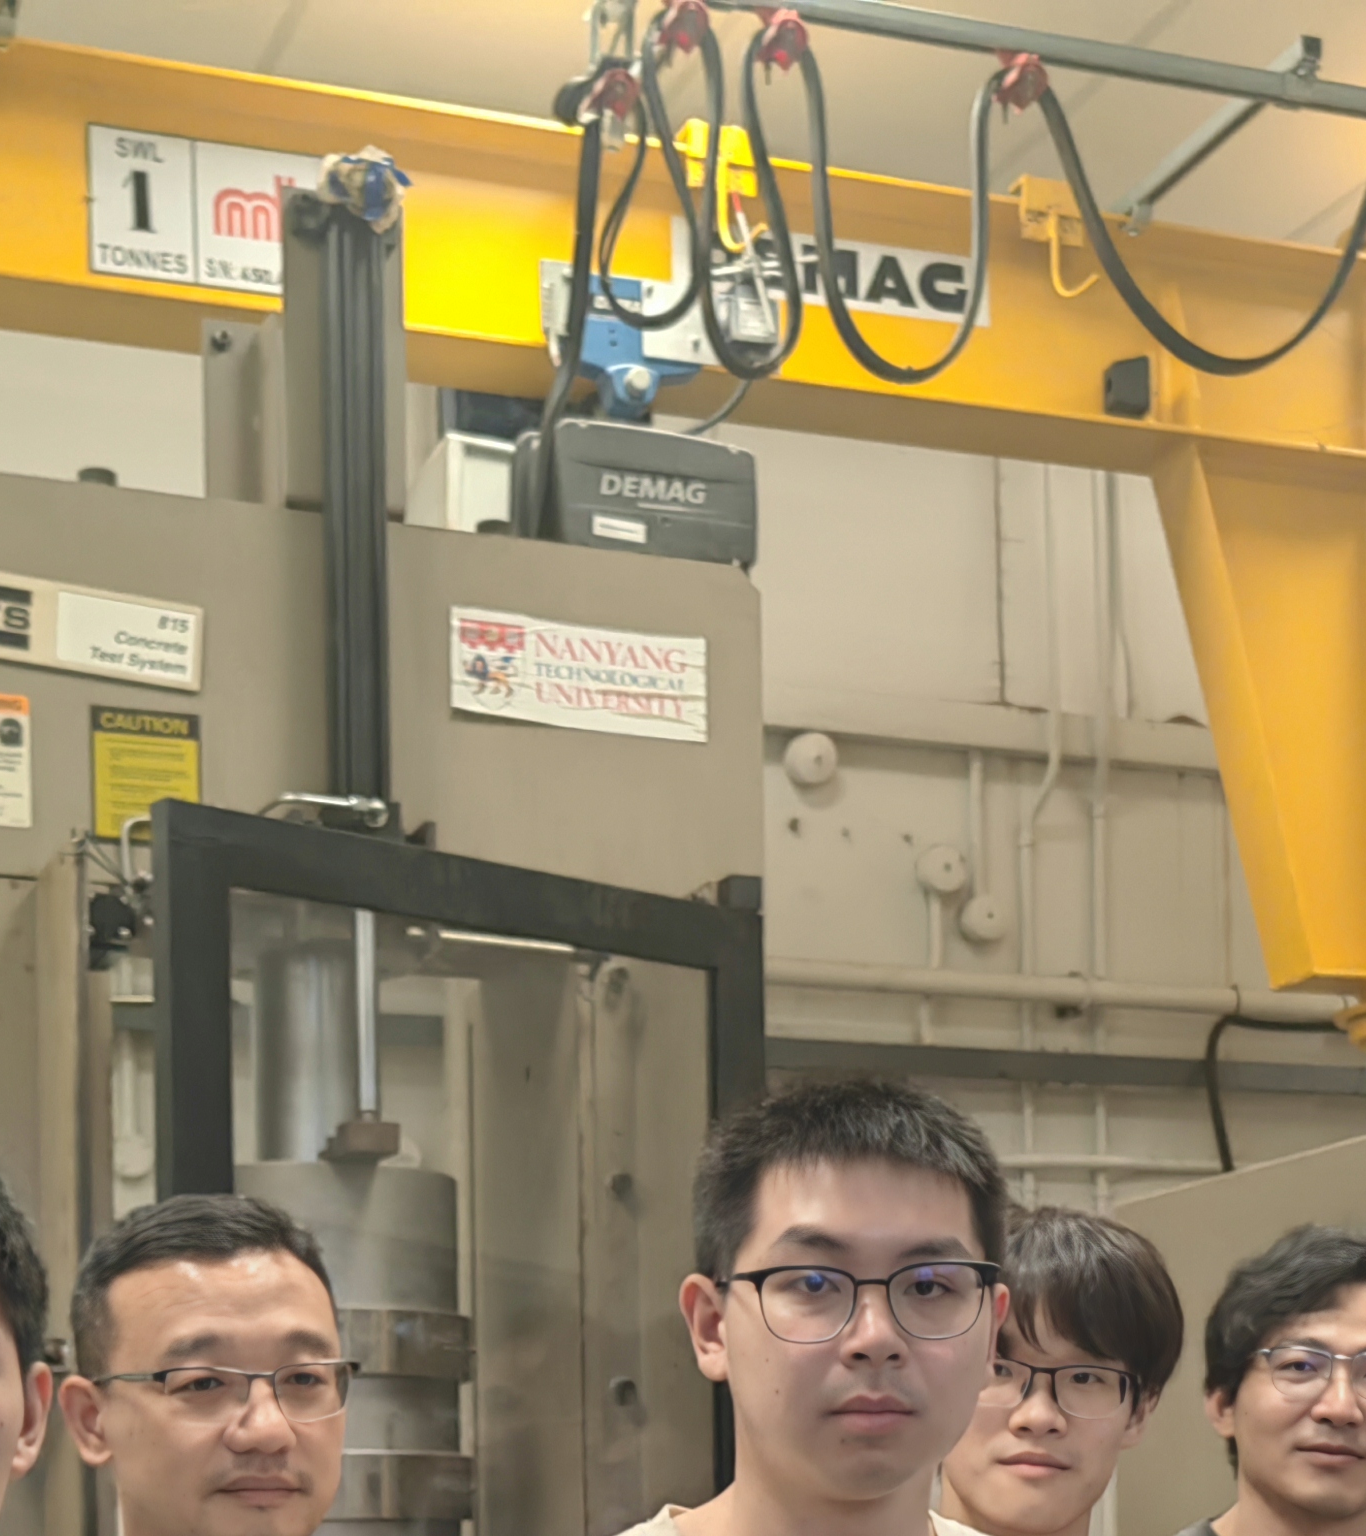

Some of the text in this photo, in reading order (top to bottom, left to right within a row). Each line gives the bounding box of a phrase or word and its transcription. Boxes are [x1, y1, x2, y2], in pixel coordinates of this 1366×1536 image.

[114, 136, 165, 164] SWL
[121, 169, 157, 234] 1
[97, 242, 189, 276] TONNES
[599, 472, 708, 505] DEMAG
[113, 630, 190, 656] Concrete
[535, 632, 688, 674] NANYANG
[90, 645, 189, 676] Test System
[534, 661, 686, 692] TECHNOLOGICAL
[535, 681, 687, 719] UNIVERSITY
[99, 712, 189, 735] CAUTION
